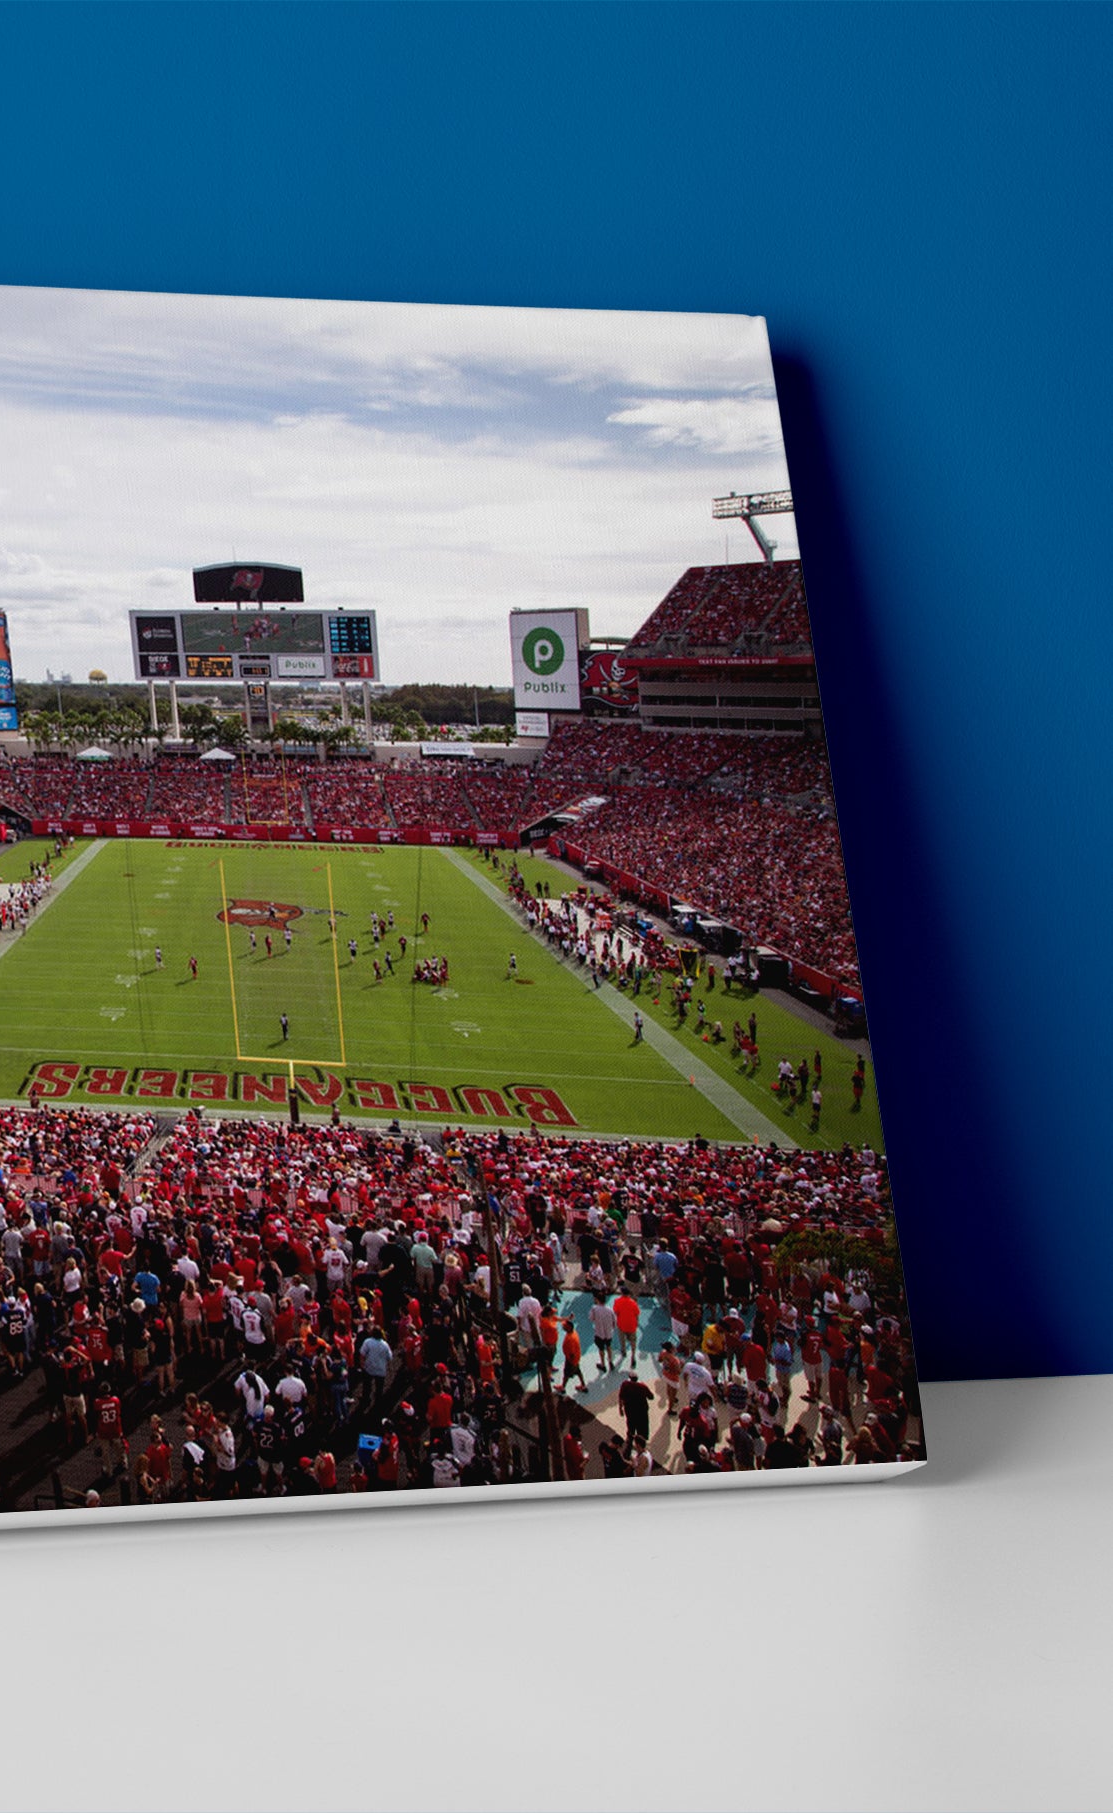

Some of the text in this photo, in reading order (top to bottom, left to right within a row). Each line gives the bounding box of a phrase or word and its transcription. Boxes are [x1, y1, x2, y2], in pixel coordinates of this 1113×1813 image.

[524, 682, 566, 694] Publix
[27, 1061, 580, 1127] BUCCANEERS
[101, 1409, 118, 1424] 83
